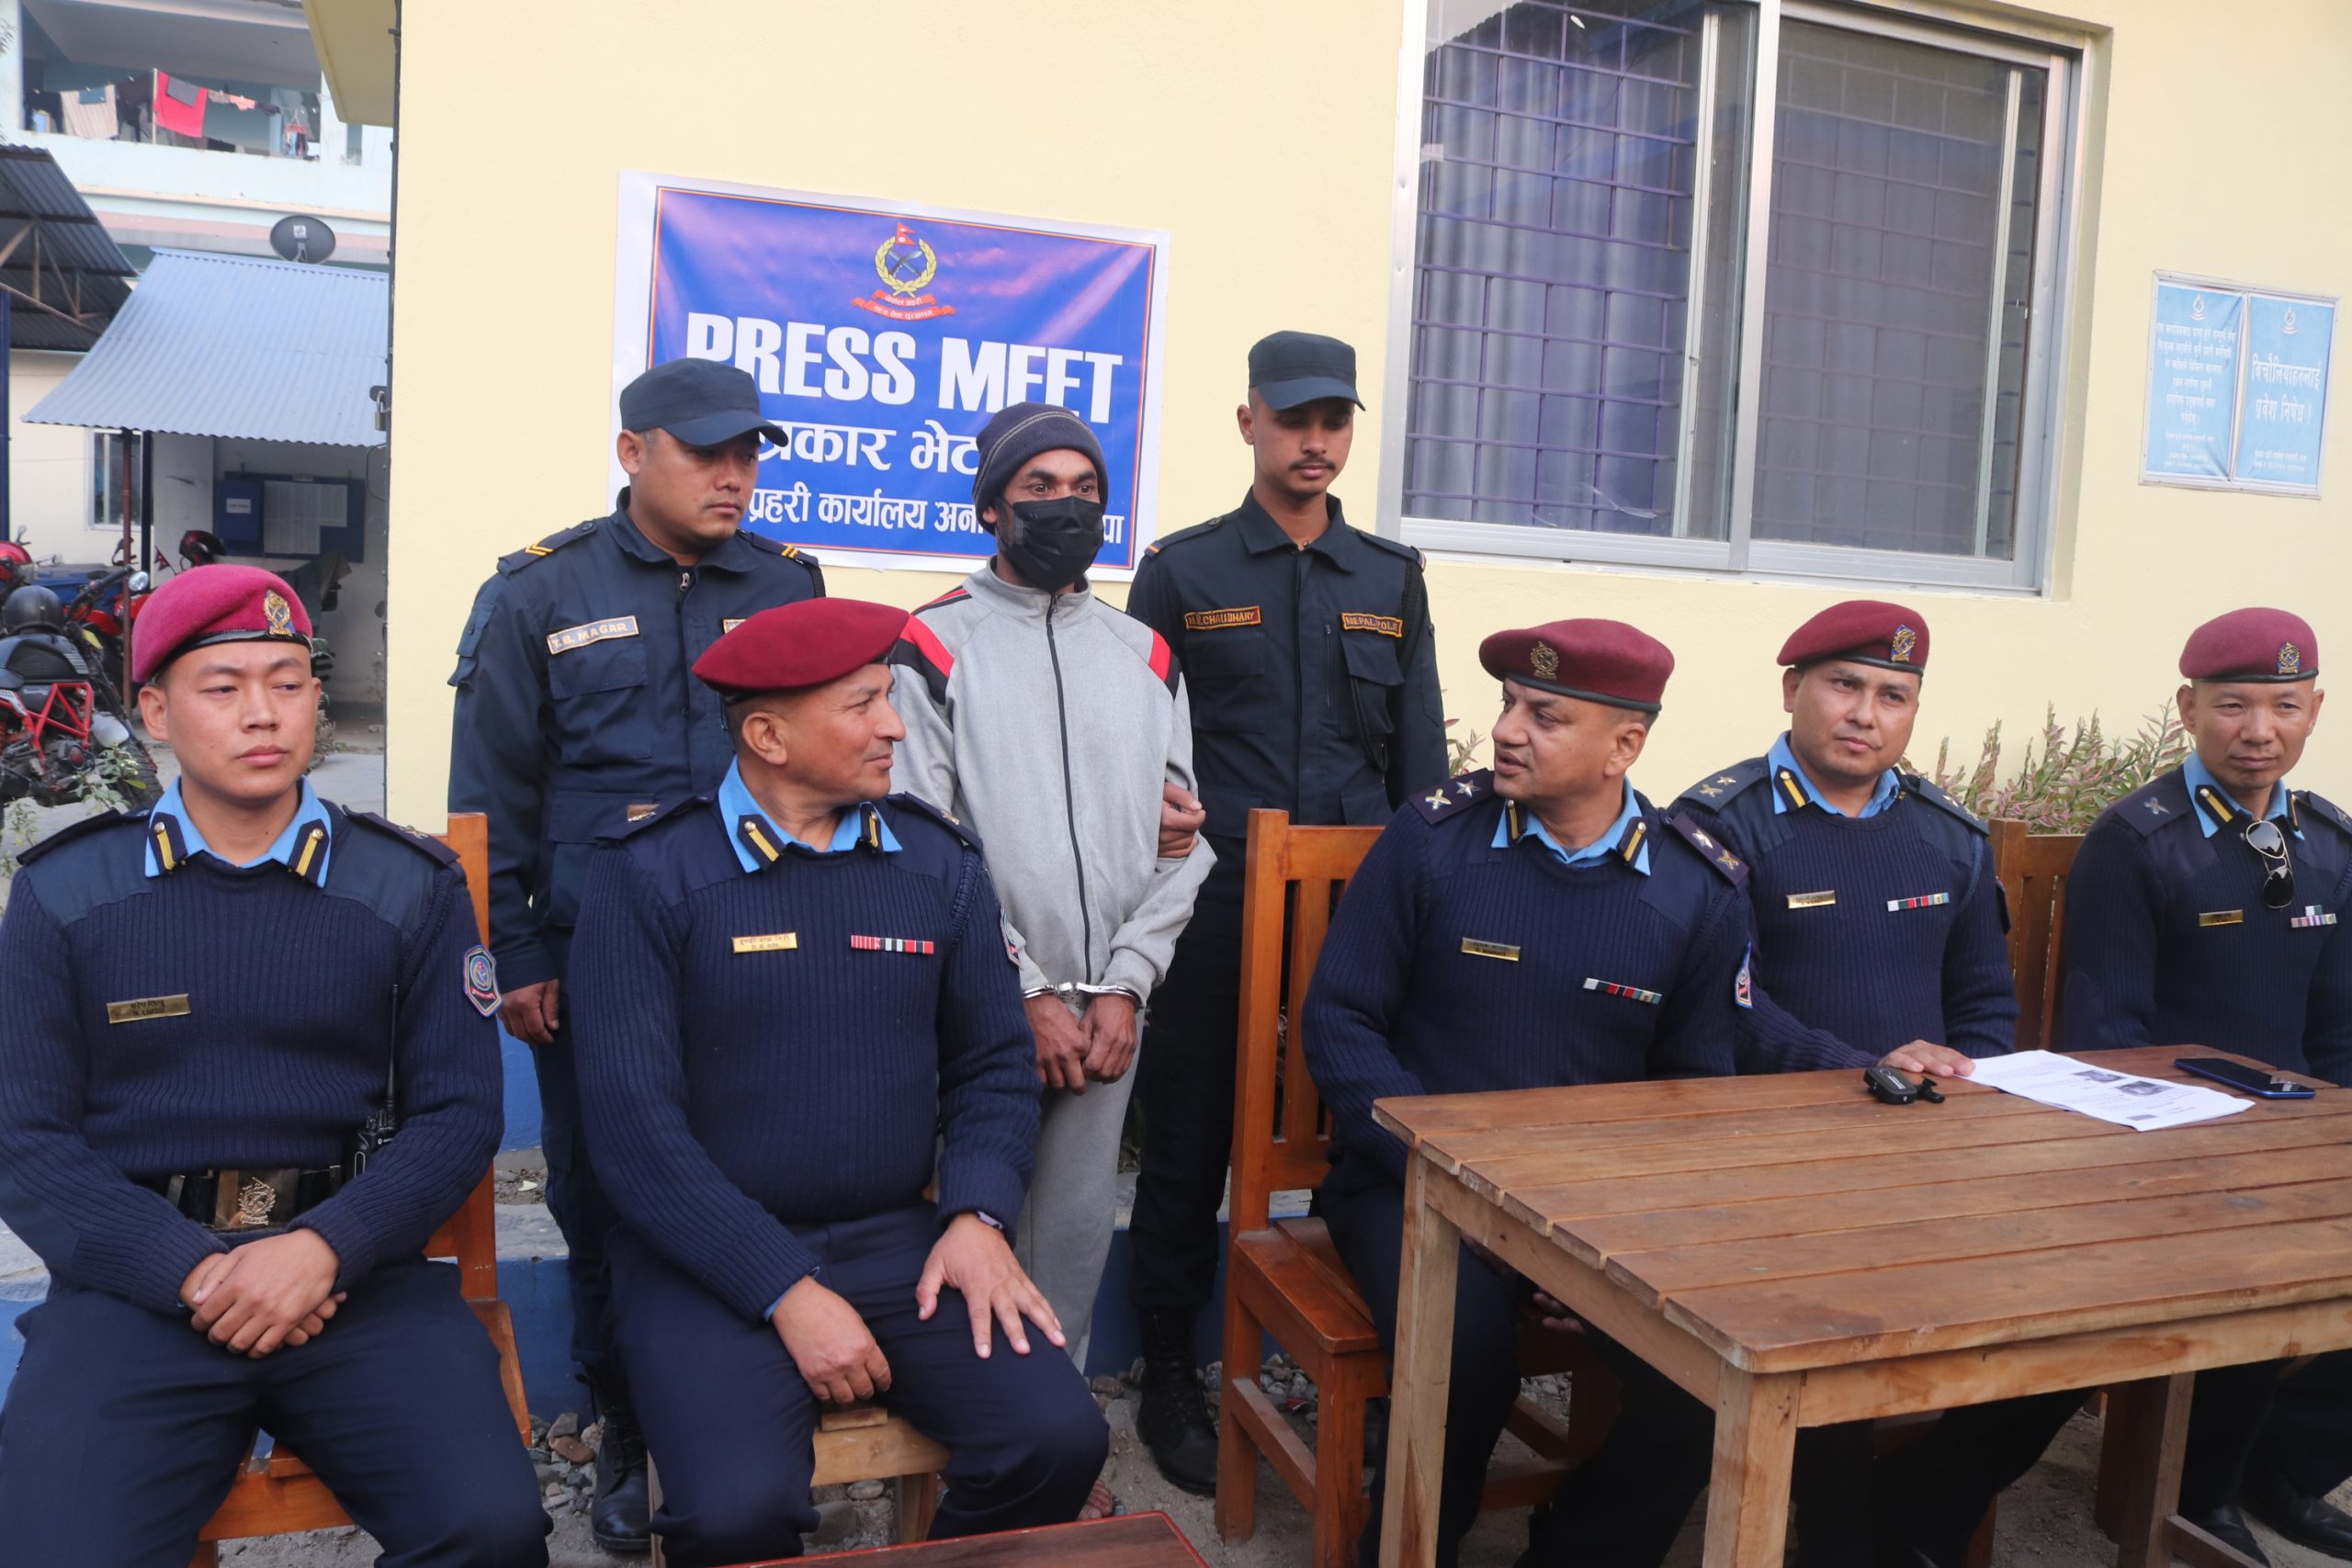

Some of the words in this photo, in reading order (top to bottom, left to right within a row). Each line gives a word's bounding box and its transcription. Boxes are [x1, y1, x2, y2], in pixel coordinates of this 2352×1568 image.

[686, 312, 916, 405] PRESS
[938, 336, 1123, 424] MEET
[748, 481, 811, 524] प्रहरी
[818, 488, 928, 530] कार्यालय
